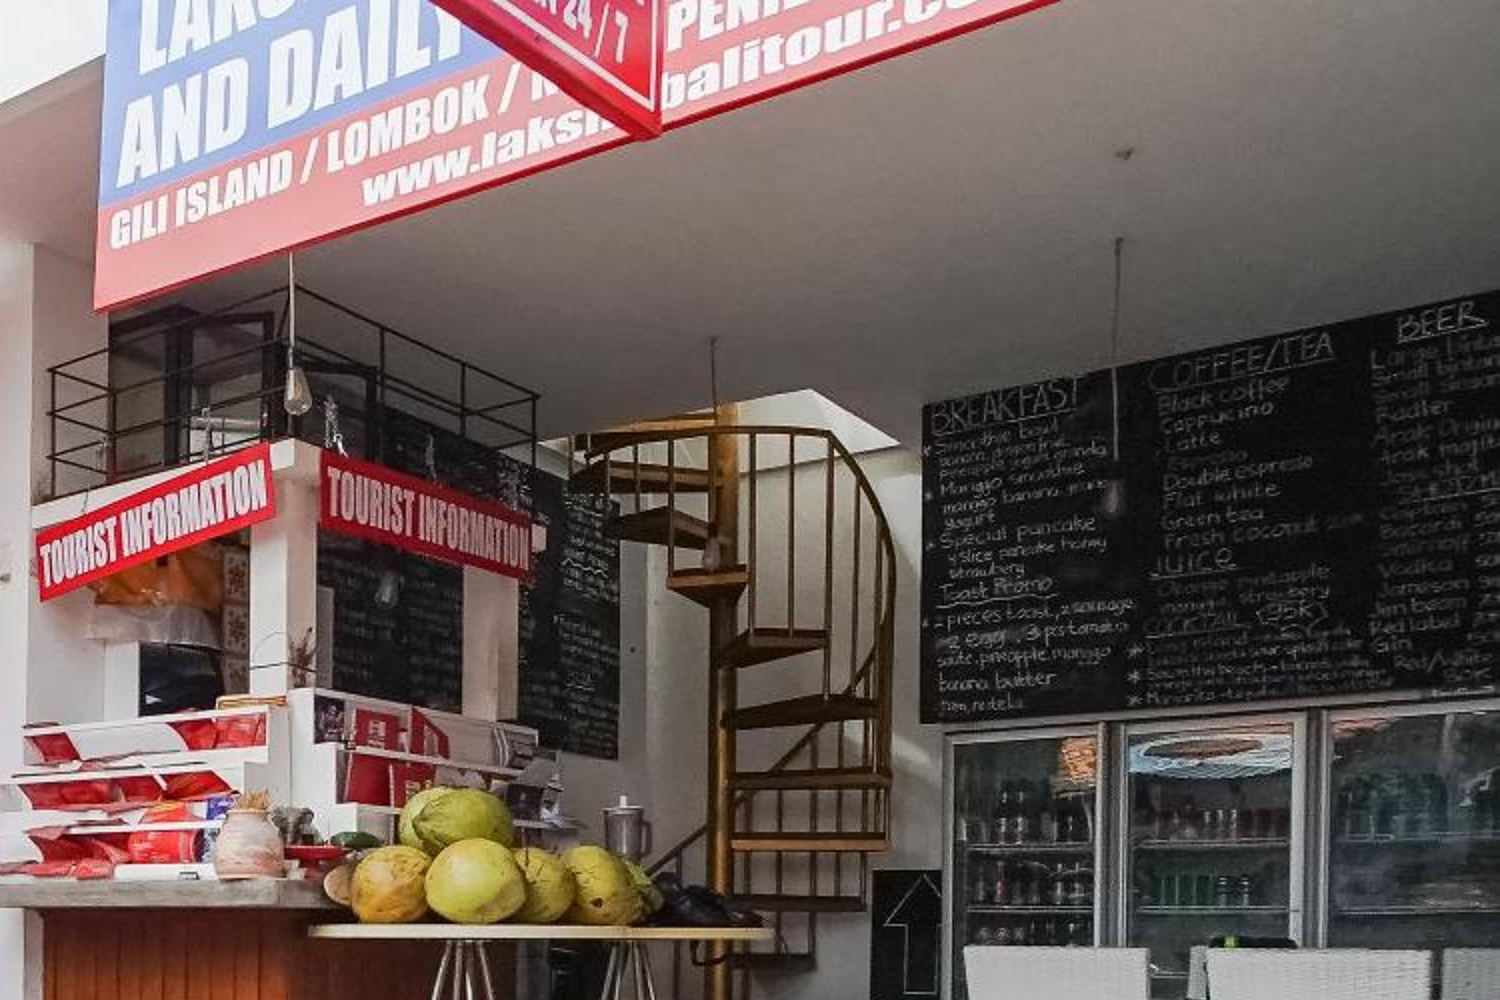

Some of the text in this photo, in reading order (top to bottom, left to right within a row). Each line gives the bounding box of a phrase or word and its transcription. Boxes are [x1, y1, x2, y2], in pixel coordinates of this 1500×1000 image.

[109, 200, 167, 249] GILI
[175, 150, 294, 227] ISLAND
[300, 138, 319, 185] /
[327, 74, 491, 173] LOMBOK
[116, 0, 463, 189] AND DAILY
[40, 459, 267, 589] TOURIST INFORMATION
[327, 467, 416, 533] TOURIST
[418, 489, 531, 571] INFORMATION
